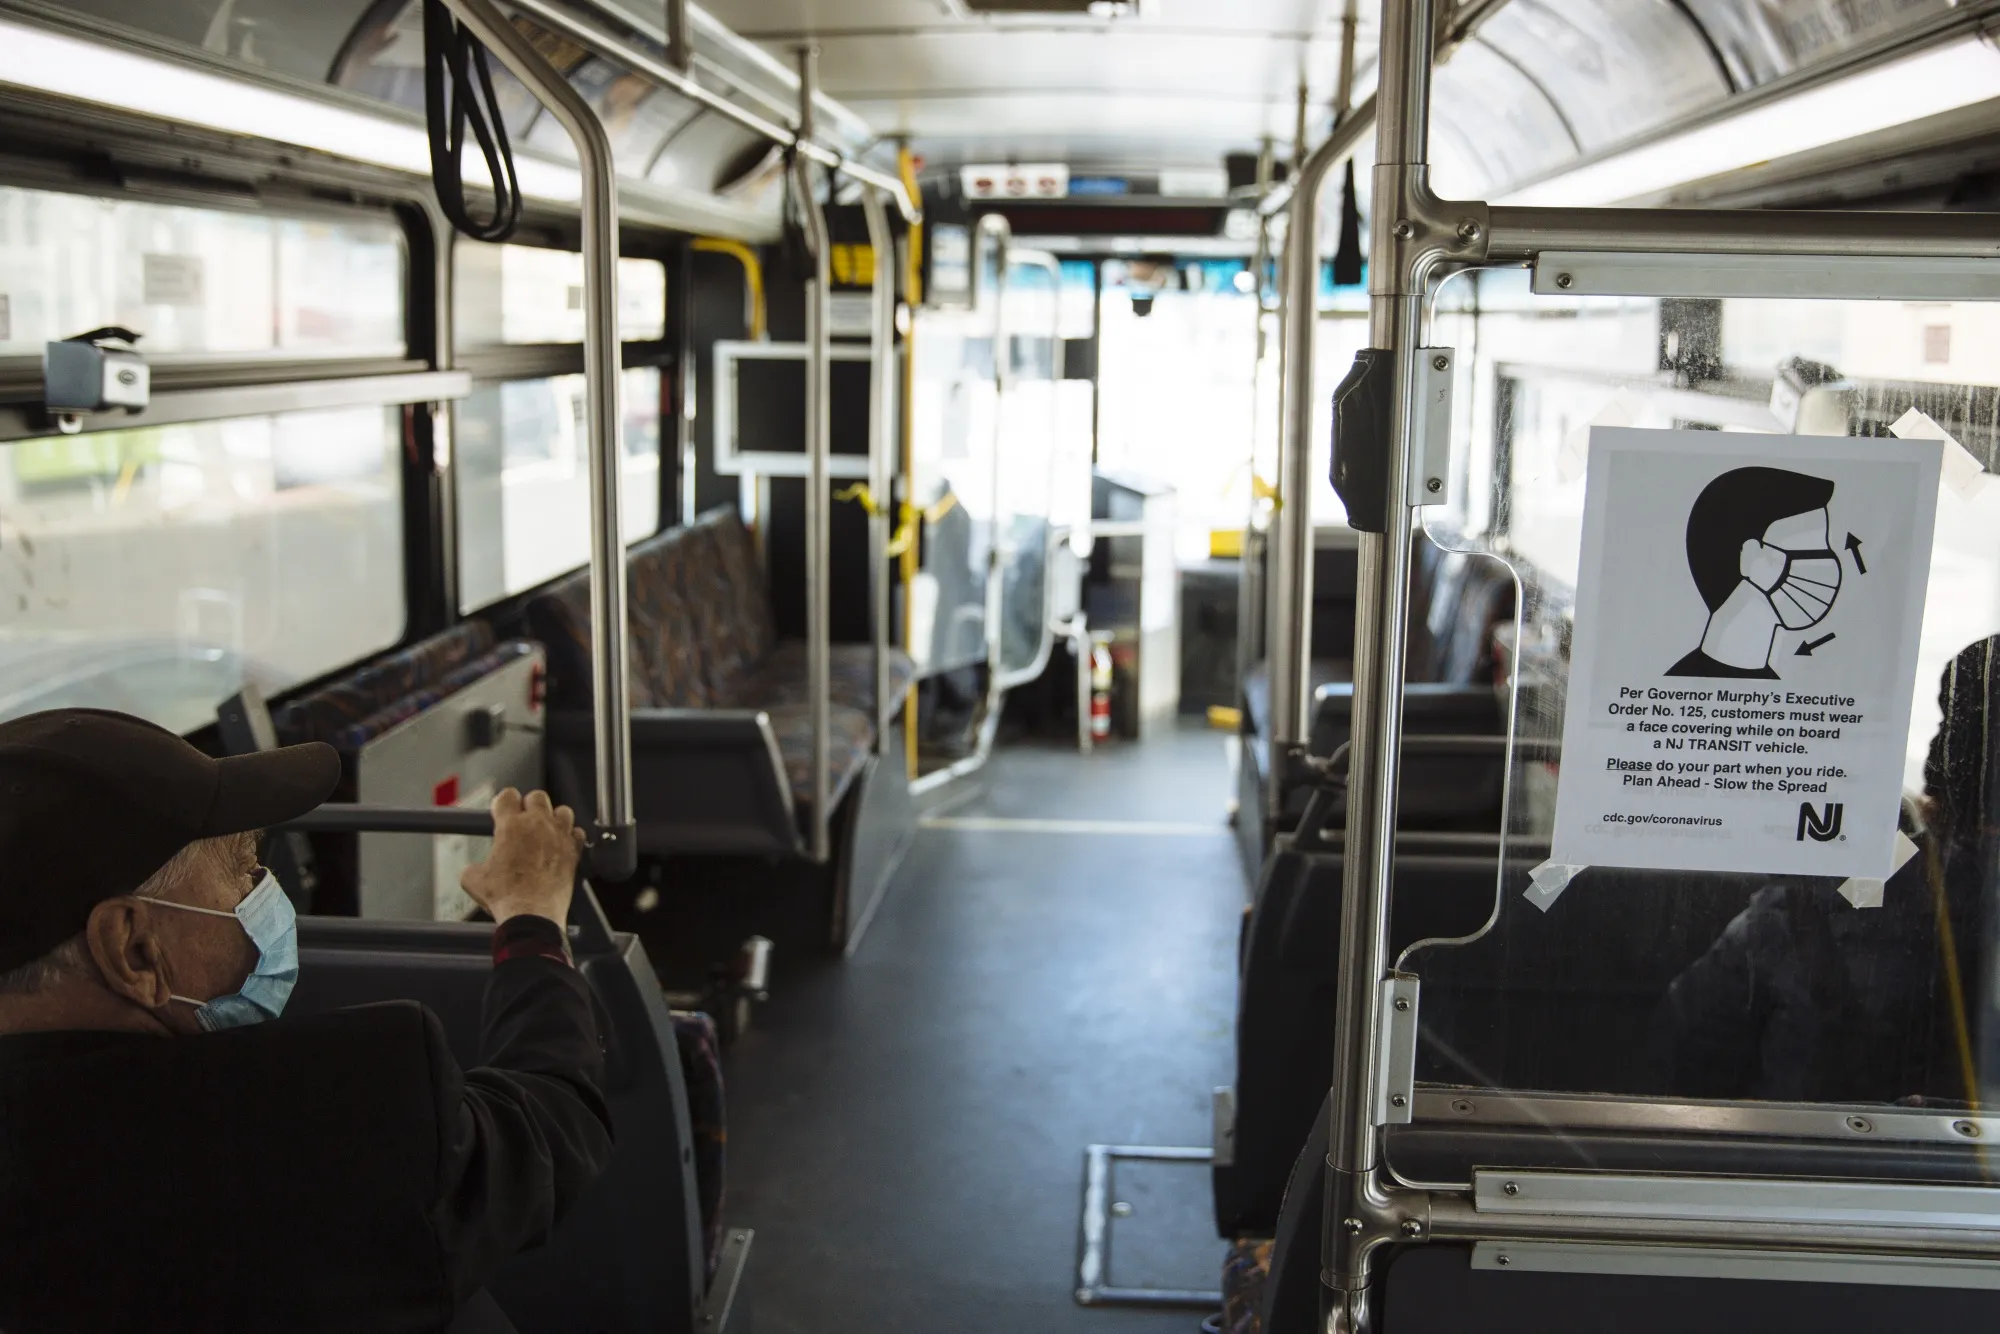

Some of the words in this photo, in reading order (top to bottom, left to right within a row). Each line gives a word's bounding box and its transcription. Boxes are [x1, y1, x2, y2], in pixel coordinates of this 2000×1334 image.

[1620, 687, 1644, 699] Per
[1647, 687, 1713, 701] Governor
[1785, 692, 1855, 707] Executive
[1608, 703, 1648, 715] Order
[1652, 704, 1674, 717] No.
[1679, 705, 1707, 720] 125,
[1711, 707, 1785, 721] customers
[1789, 711, 1825, 722] must
[1829, 713, 1864, 724] wear
[1626, 722, 1635, 732] a
[1639, 720, 1668, 733] face
[1671, 723, 1732, 738] covering
[1736, 724, 1774, 737] while
[1777, 727, 1795, 737] on
[1799, 726, 1840, 739] board
[1653, 739, 1661, 749] a
[1665, 738, 1684, 750] NJ
[1688, 738, 1752, 752] TRANSIT
[1755, 741, 1808, 754] vehicle.
[1606, 758, 1652, 772] Please
[1656, 759, 1674, 771] do
[1677, 762, 1710, 774] your
[1713, 762, 1741, 776] part
[1745, 763, 1782, 775] when
[1786, 766, 1812, 778] you
[1816, 765, 1847, 778] ride.
[1623, 774, 1653, 787] Plan
[1656, 775, 1701, 788] Ahead
[1713, 777, 1748, 790] Slow
[1751, 779, 1774, 791] the
[1777, 779, 1827, 794] Spread
[1603, 812, 1722, 826] cdc.gov/coronavirus
